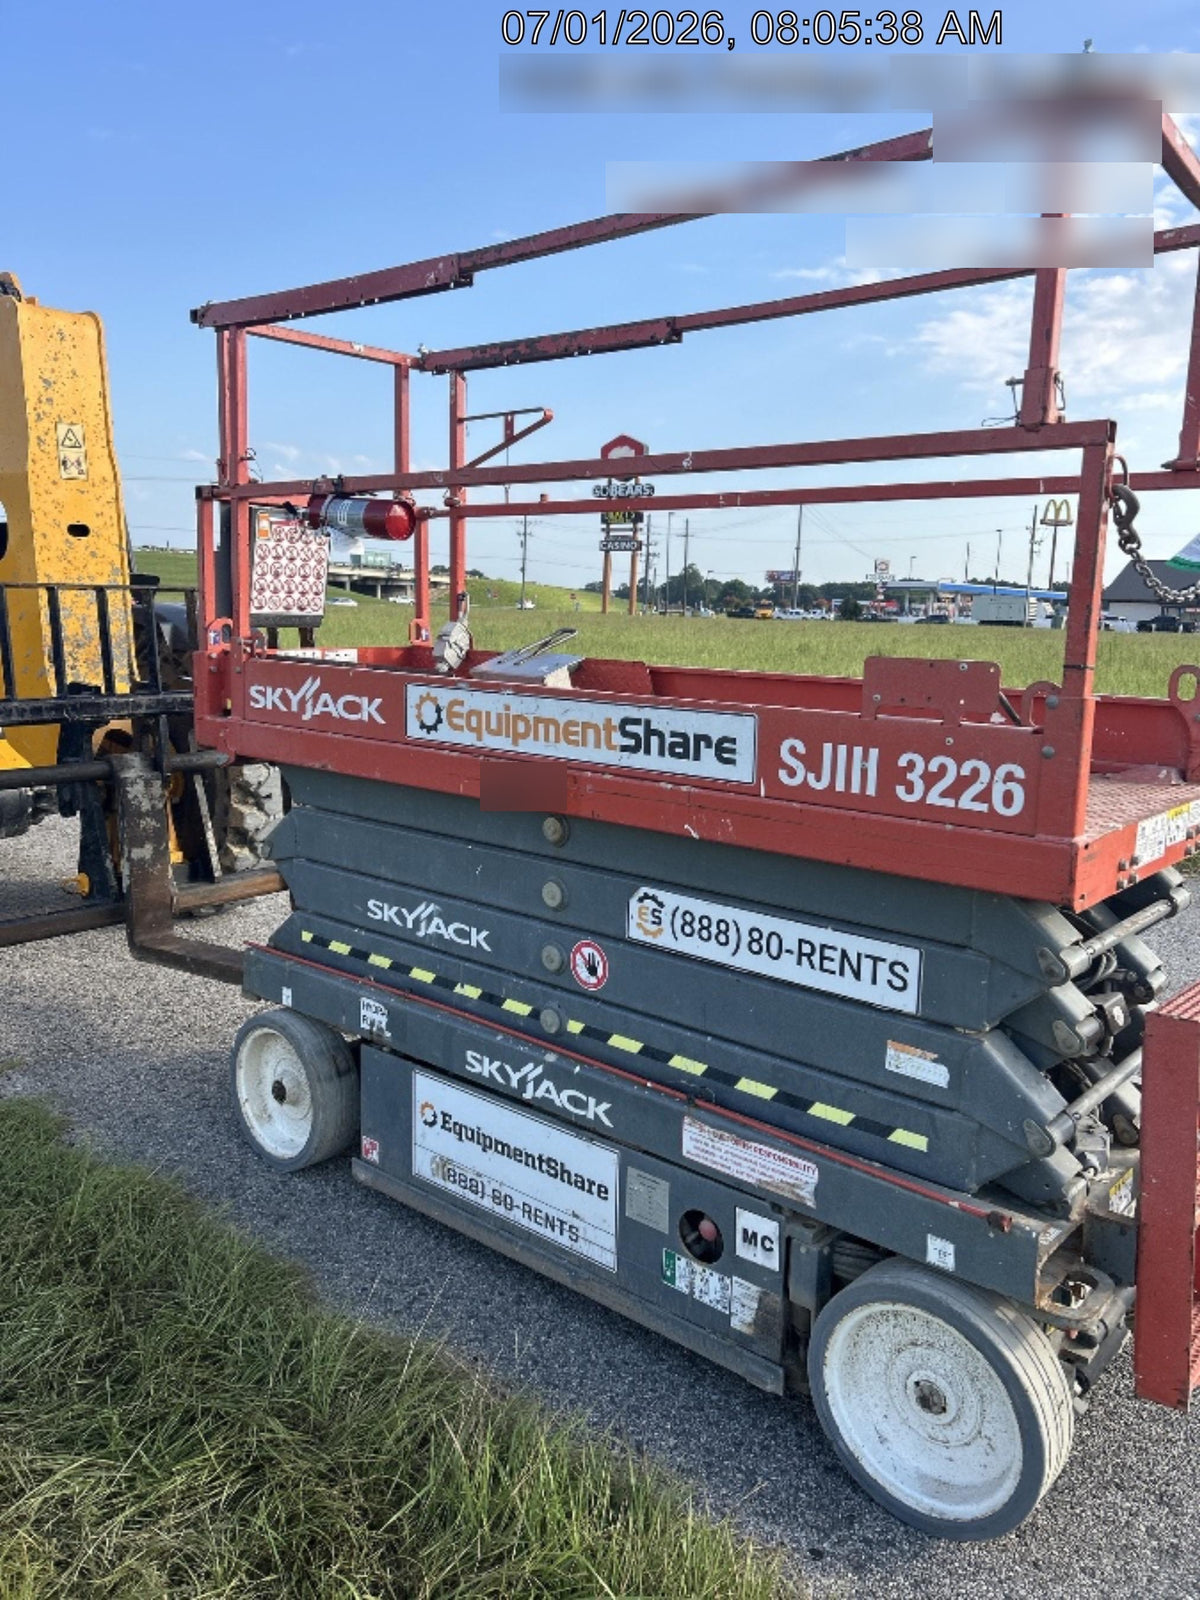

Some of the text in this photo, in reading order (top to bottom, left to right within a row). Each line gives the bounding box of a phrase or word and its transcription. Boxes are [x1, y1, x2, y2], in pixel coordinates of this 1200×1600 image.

[600, 541, 638, 551] CASINO
[249, 676, 386, 725] SKYJACK
[445, 698, 738, 767] EquipmentShare
[895, 751, 1026, 817] 3226
[367, 899, 492, 952] SKYJACK
[465, 1050, 615, 1128] SKYJACK
[440, 1110, 610, 1201] EquipmentShare
[741, 1228, 775, 1253] MC
